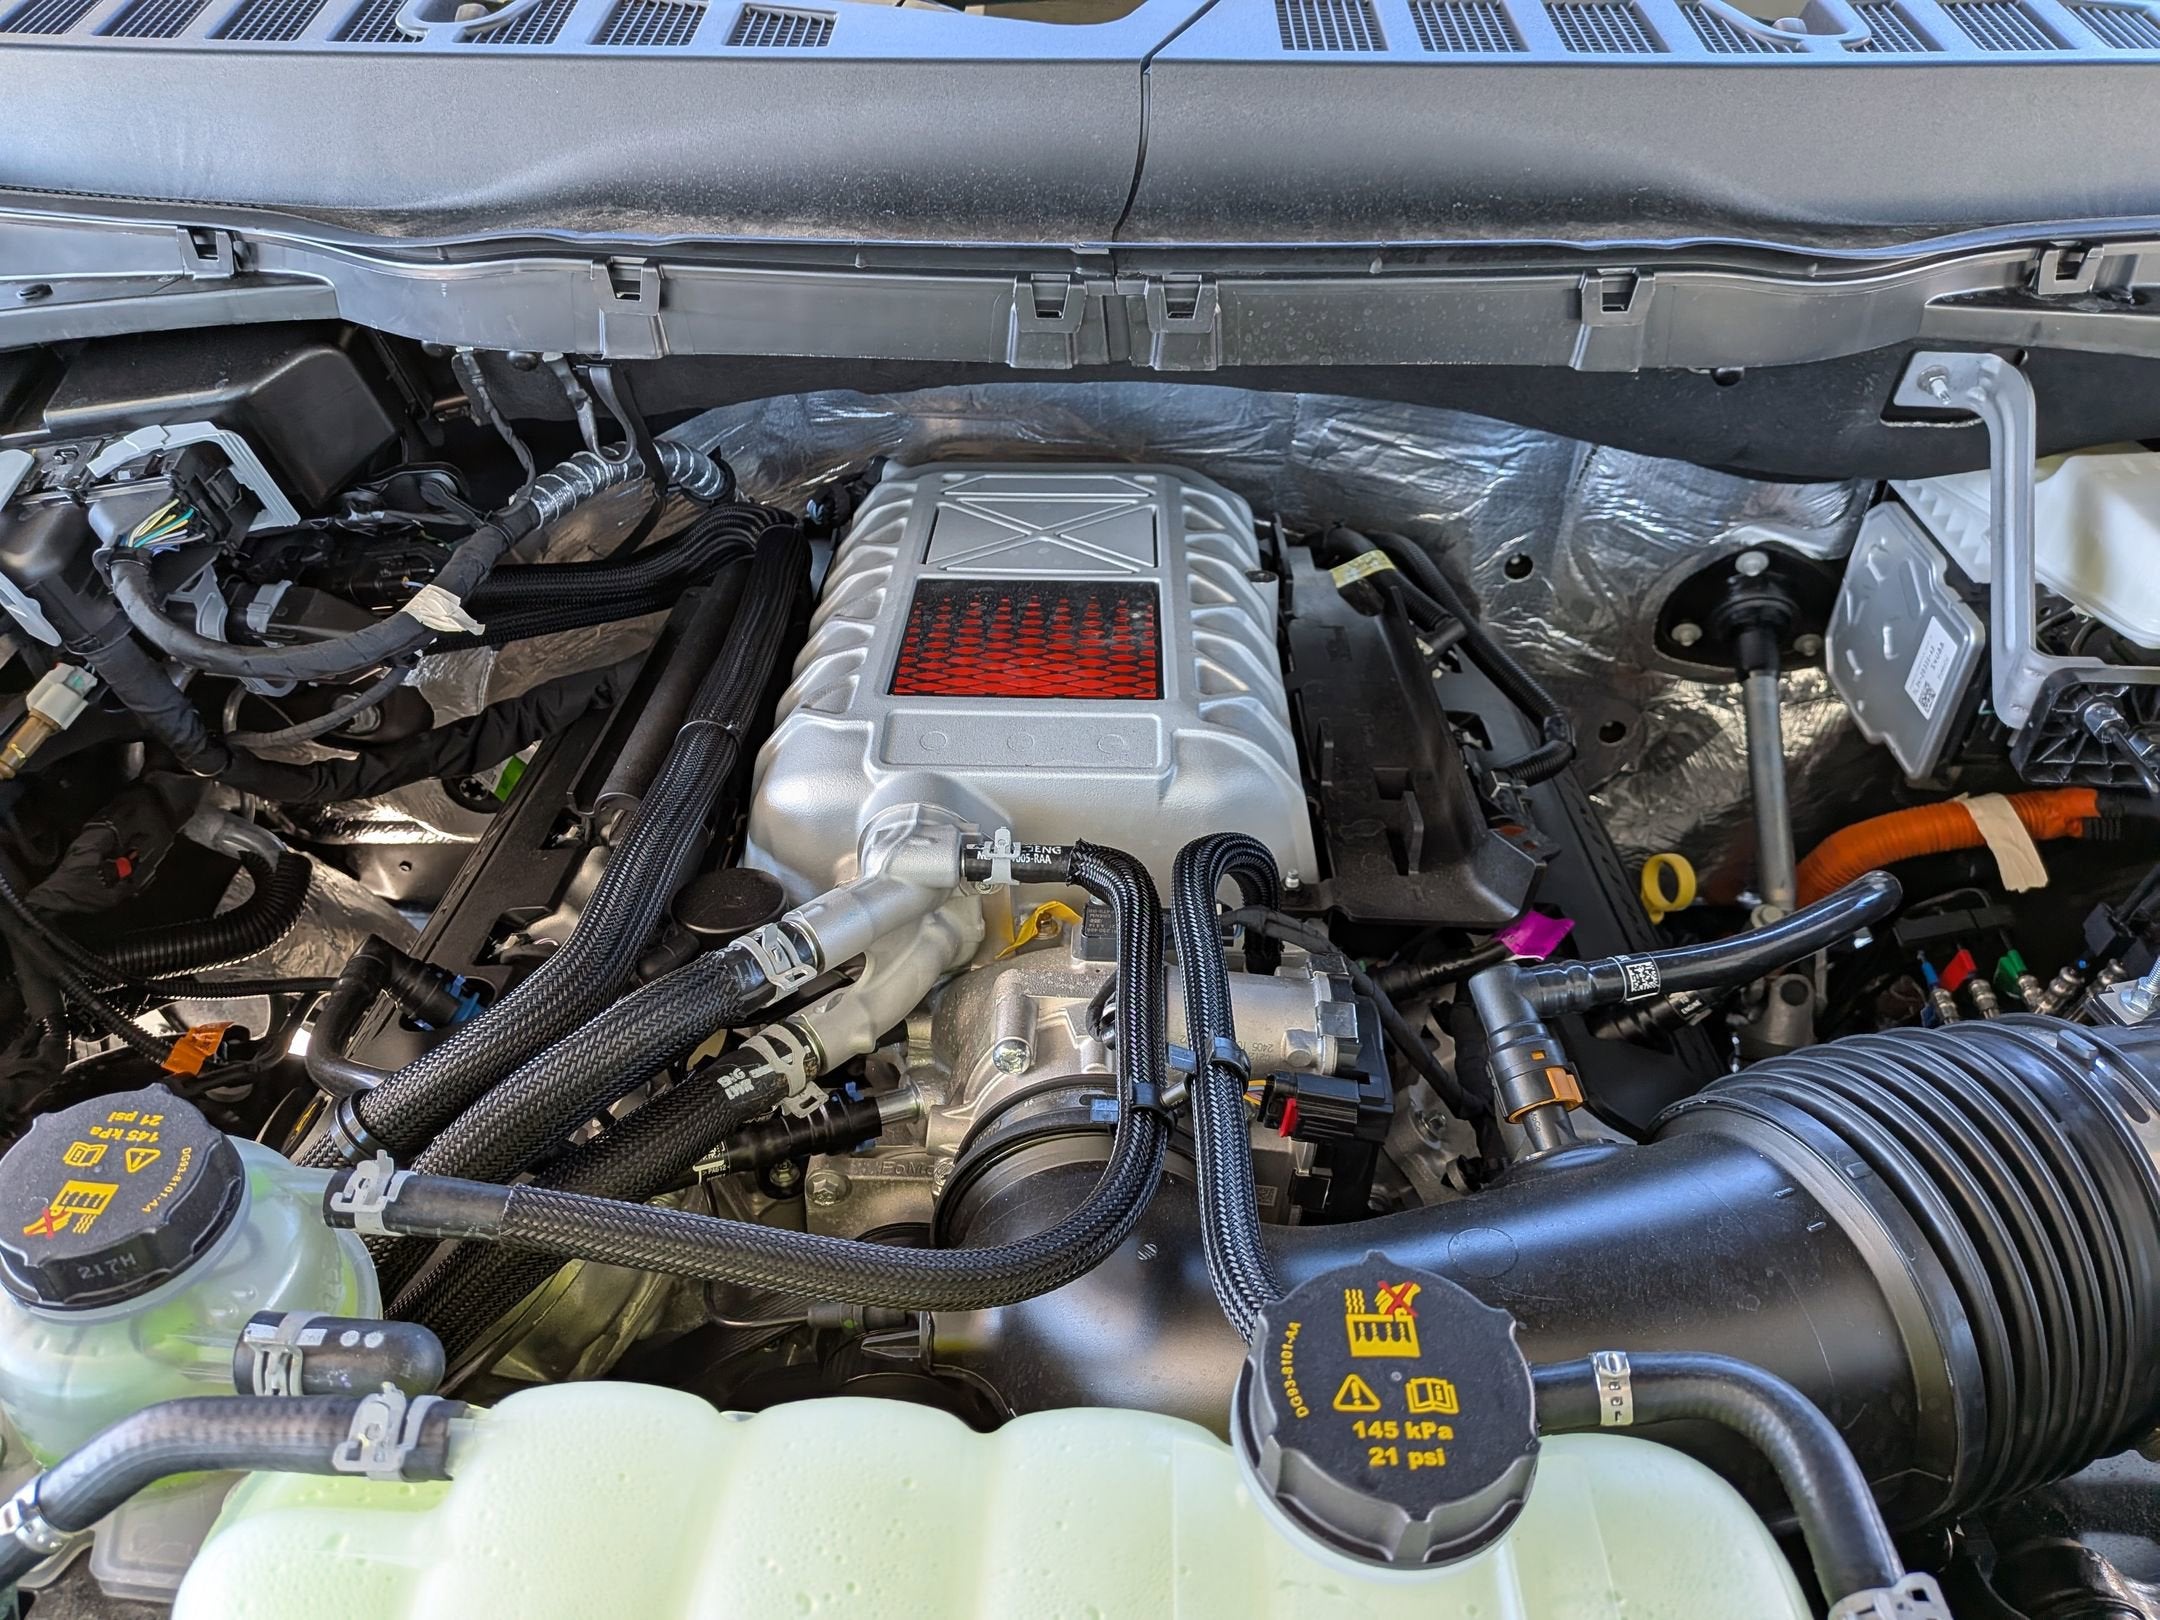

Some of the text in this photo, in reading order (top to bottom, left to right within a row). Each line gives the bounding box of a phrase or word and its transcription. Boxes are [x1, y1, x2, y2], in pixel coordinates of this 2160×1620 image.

[107, 1110, 164, 1126] 21 psi
[90, 1126, 160, 1142] 145 kPa
[142, 1147, 192, 1213] DG93-8101-AA
[1280, 1321, 1310, 1419] DG93-8101-AA
[1352, 1420, 1454, 1441] 145 kPa
[1368, 1447, 1447, 1471] 21 psi
